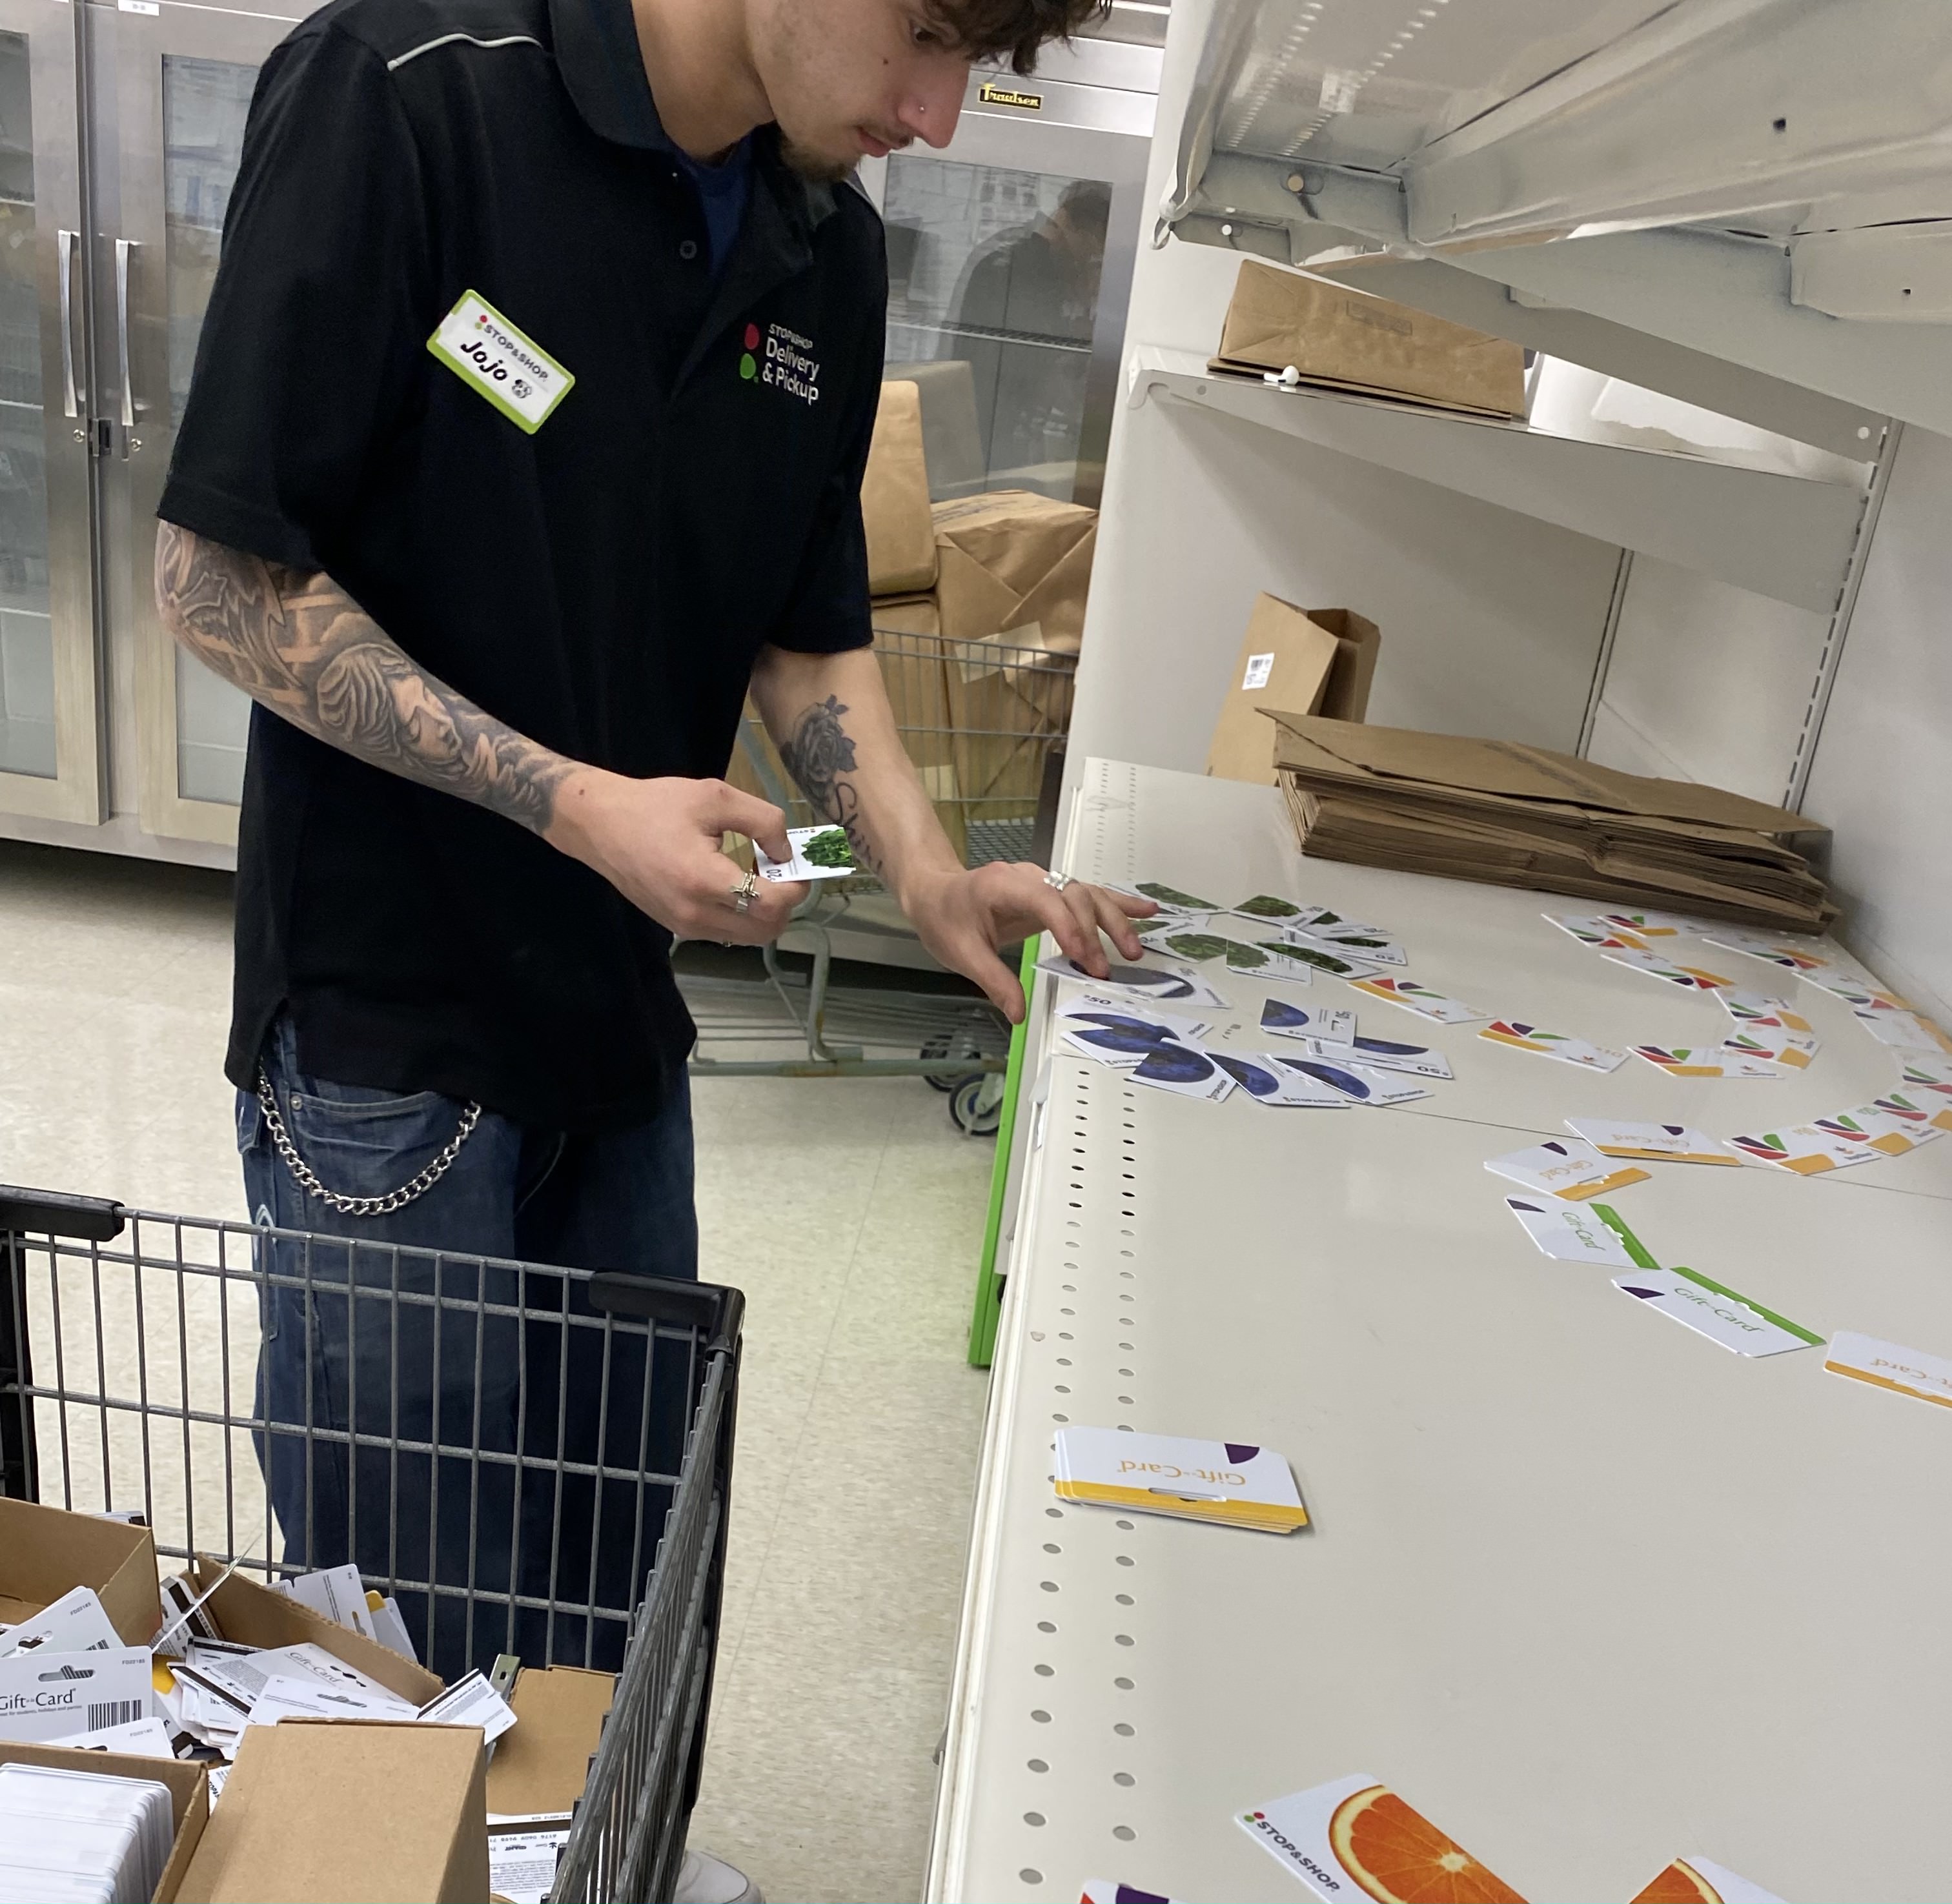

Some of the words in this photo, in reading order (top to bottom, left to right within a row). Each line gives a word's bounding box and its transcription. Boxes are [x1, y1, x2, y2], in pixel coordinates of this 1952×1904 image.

[766, 336, 820, 381] Delivery
[762, 361, 774, 384] &
[775, 366, 818, 406] Pickup
[1257, 1821, 1341, 1892] STOP&SHOP
